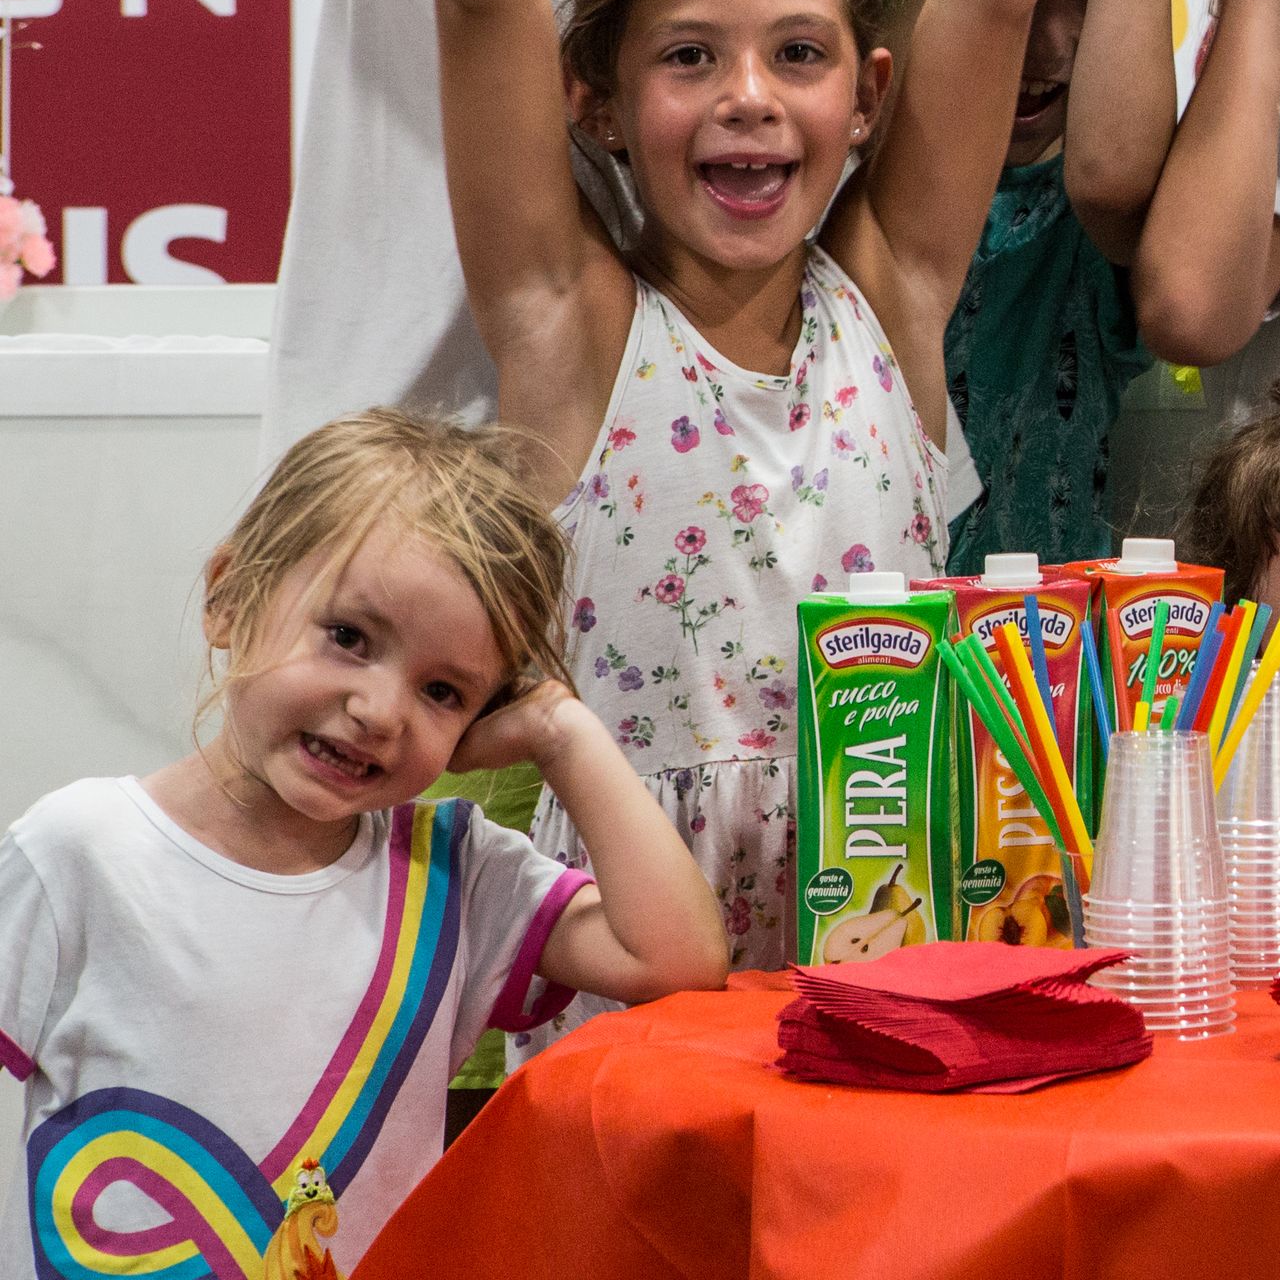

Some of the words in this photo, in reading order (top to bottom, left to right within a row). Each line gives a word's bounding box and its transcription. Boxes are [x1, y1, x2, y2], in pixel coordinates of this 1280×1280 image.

[825, 627, 922, 657] sterilgarda
[857, 655, 891, 664] alimenti
[829, 680, 897, 708] succo
[844, 711, 857, 727] e
[859, 696, 920, 732] polpa
[845, 734, 907, 859] PERA
[807, 885, 849, 898] genuinità
